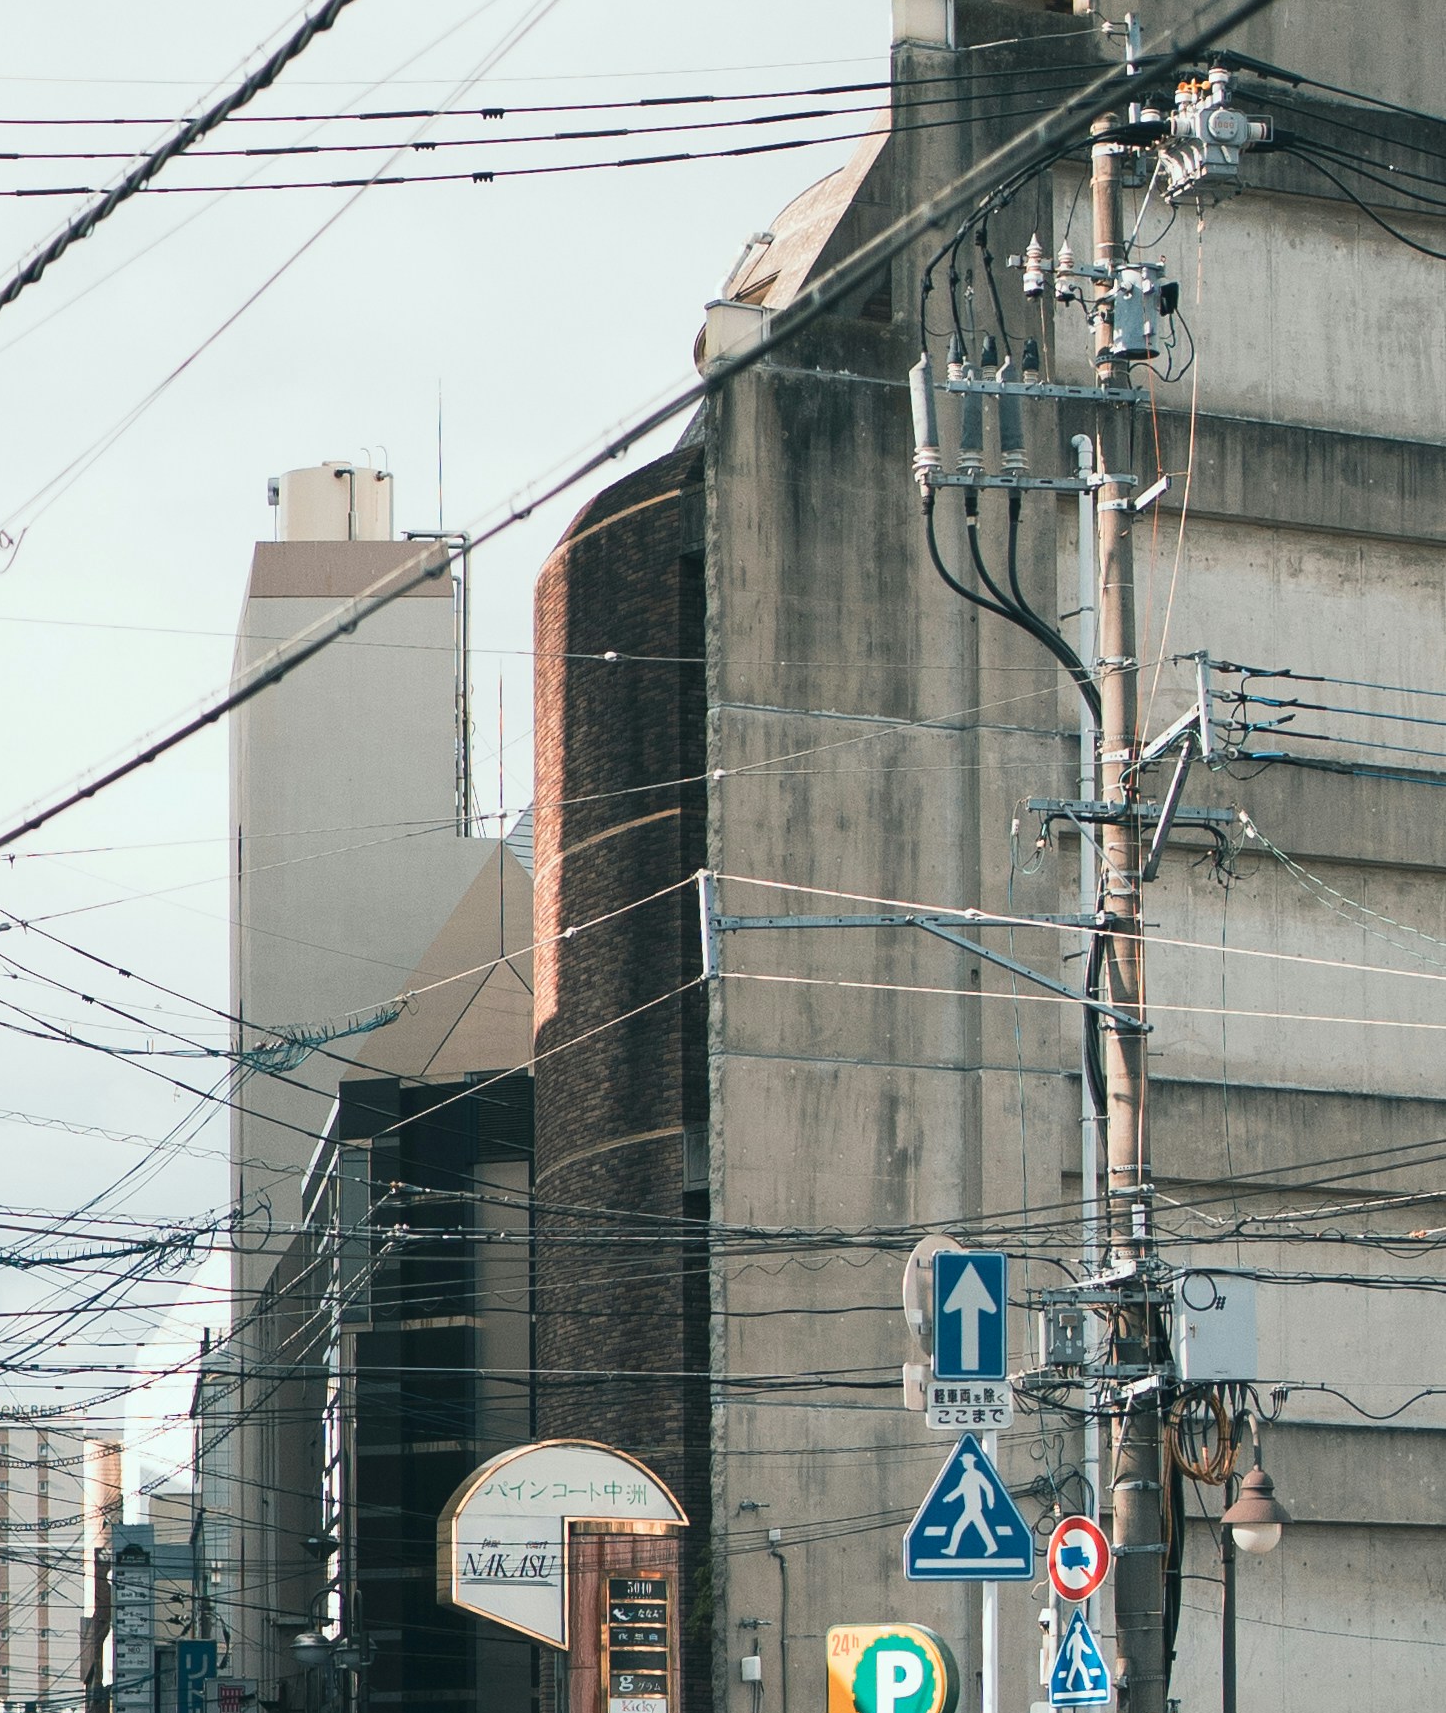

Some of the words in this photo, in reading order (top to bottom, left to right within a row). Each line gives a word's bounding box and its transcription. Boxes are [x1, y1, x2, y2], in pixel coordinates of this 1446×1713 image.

[934, 1388, 1005, 1404] 軽車両を除く
[938, 1409, 1005, 1424] ここまで
[484, 1480, 647, 1506] パインコート中洲
[462, 1553, 557, 1578] NAKASU
